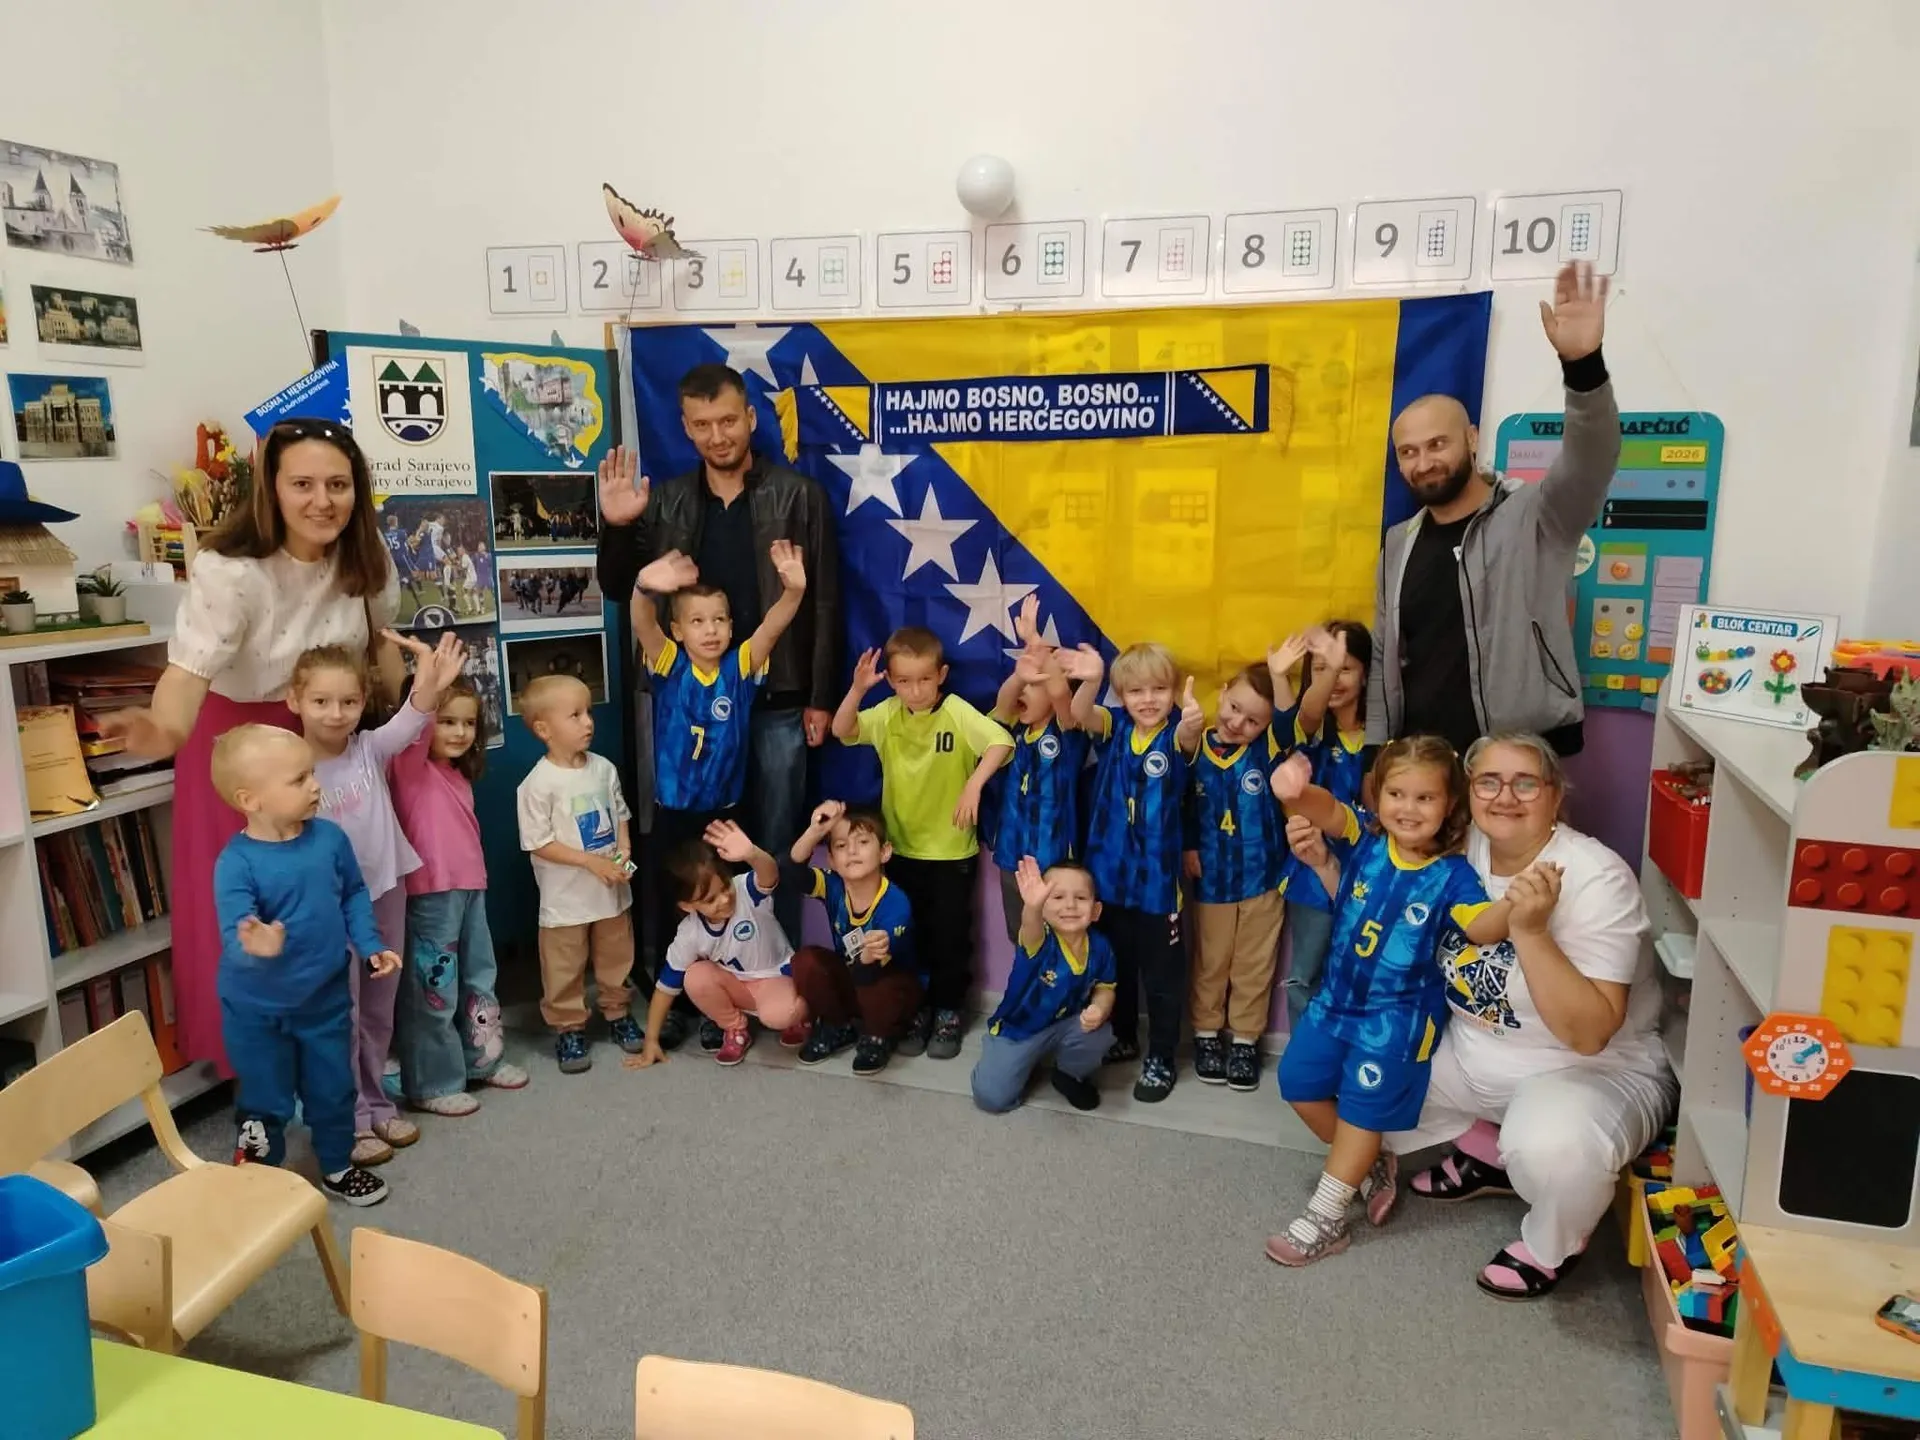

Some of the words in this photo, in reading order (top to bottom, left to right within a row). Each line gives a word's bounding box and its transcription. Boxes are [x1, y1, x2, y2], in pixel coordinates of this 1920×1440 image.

[1241, 233, 1266, 268] 8
[1375, 223, 1398, 258] 9
[1501, 217, 1556, 255] 10
[893, 253, 911, 284] 5
[1001, 243, 1022, 276] 6
[1120, 240, 1142, 272] 7
[502, 266, 518, 293] 1
[592, 260, 609, 289] 2
[687, 260, 704, 289] 3
[786, 257, 806, 288] 4
[255, 397, 283, 417] BOSNA
[287, 360, 340, 397] HERCEGOVINA
[886, 388, 960, 411] HAJMO
[967, 385, 1050, 411] BOSNO,
[1058, 382, 1159, 406] BOSNO...
[890, 410, 982, 434] ...HAJMO
[989, 406, 1155, 433] HERCEGOVINO
[407, 457, 471, 474] Sarajevo
[1666, 449, 1700, 459] 2026
[374, 475, 391, 489] ity
[395, 475, 411, 487] of
[414, 474, 472, 488] Sarajevo
[387, 536, 400, 550] 15
[1717, 617, 1745, 630] BLOK
[1747, 621, 1793, 636] CENTAR
[691, 725, 705, 761] 7
[936, 731, 954, 753] 10
[1020, 773, 1029, 796] 4
[1220, 809, 1236, 837] 4
[1354, 919, 1384, 958] 5
[1792, 1036, 1807, 1044] 12
